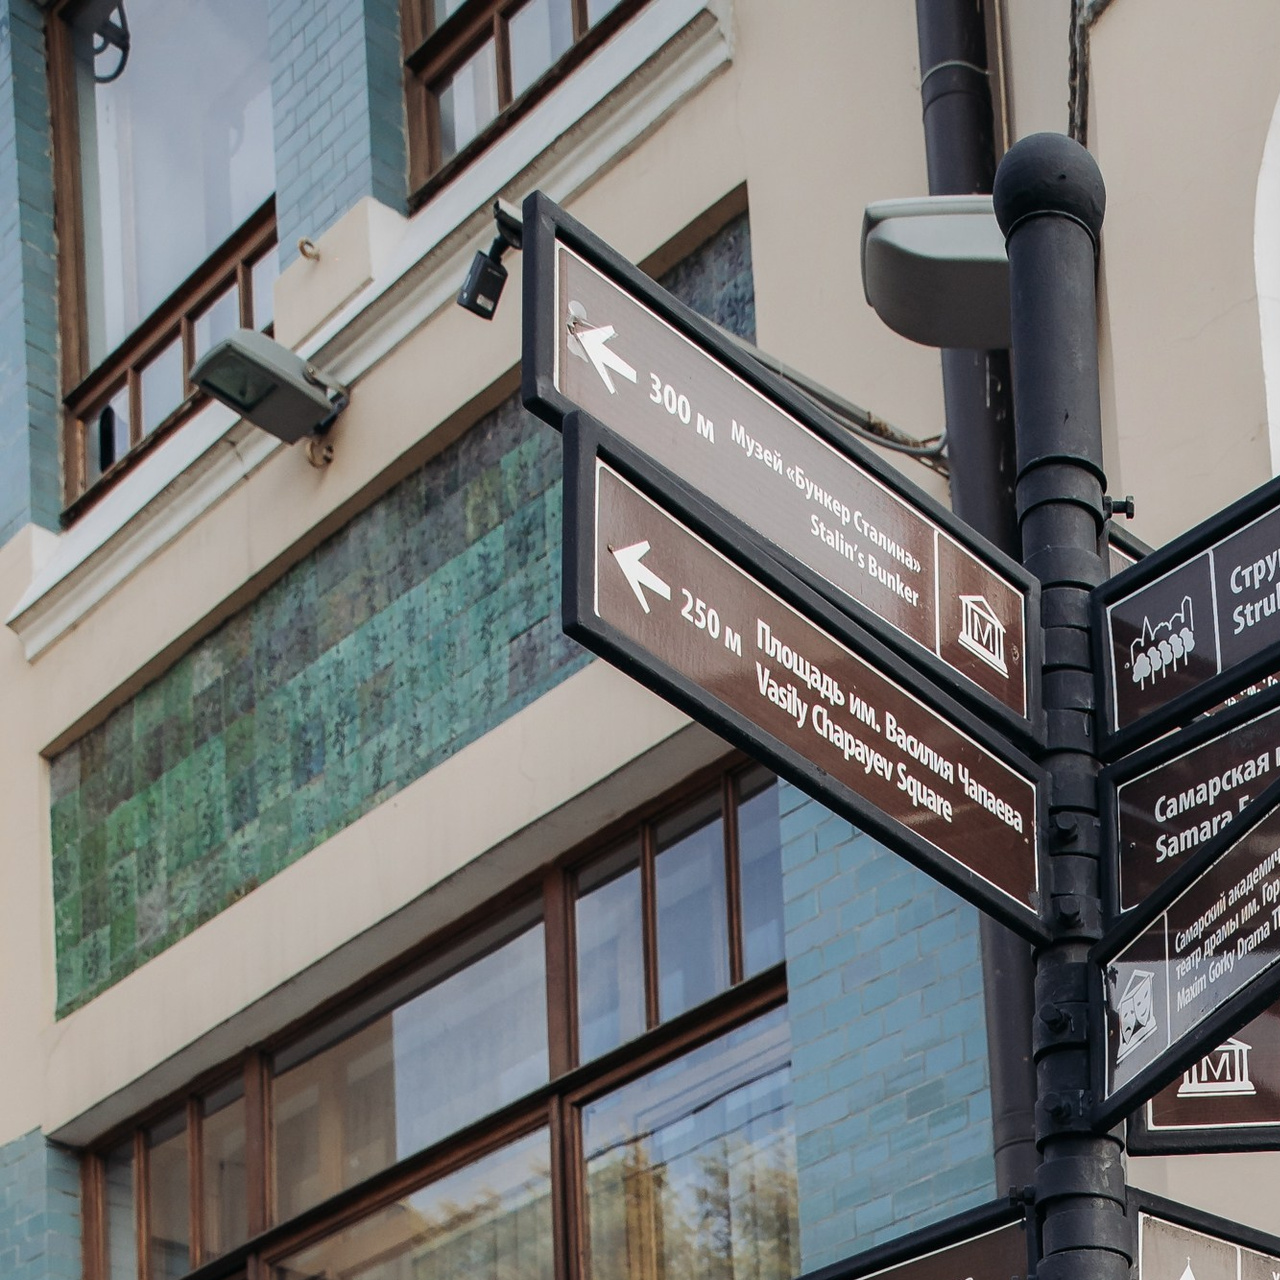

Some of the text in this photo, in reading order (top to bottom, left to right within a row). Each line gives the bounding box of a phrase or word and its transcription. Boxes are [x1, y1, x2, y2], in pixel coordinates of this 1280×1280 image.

[650, 373, 714, 444] 300 м
[731, 419, 921, 572] Музей «Бункер Сталина»
[811, 514, 918, 606] Stalin’s Bunker
[681, 588, 741, 657] 250 м
[755, 661, 952, 823] Vasily Chapayev Square
[757, 618, 1023, 833] Площадь им. Василия Чапаева
[1155, 752, 1270, 822] Самарская
[1156, 810, 1232, 863] Samara
[1175, 891, 1226, 953] Самарский
[1176, 949, 1203, 980] театр
[1203, 914, 1239, 960] драмы
[1241, 898, 1260, 924] им.
[1177, 974, 1207, 1011] Maxim
[1209, 949, 1235, 983] Gorky
[1237, 924, 1270, 960] Drama
